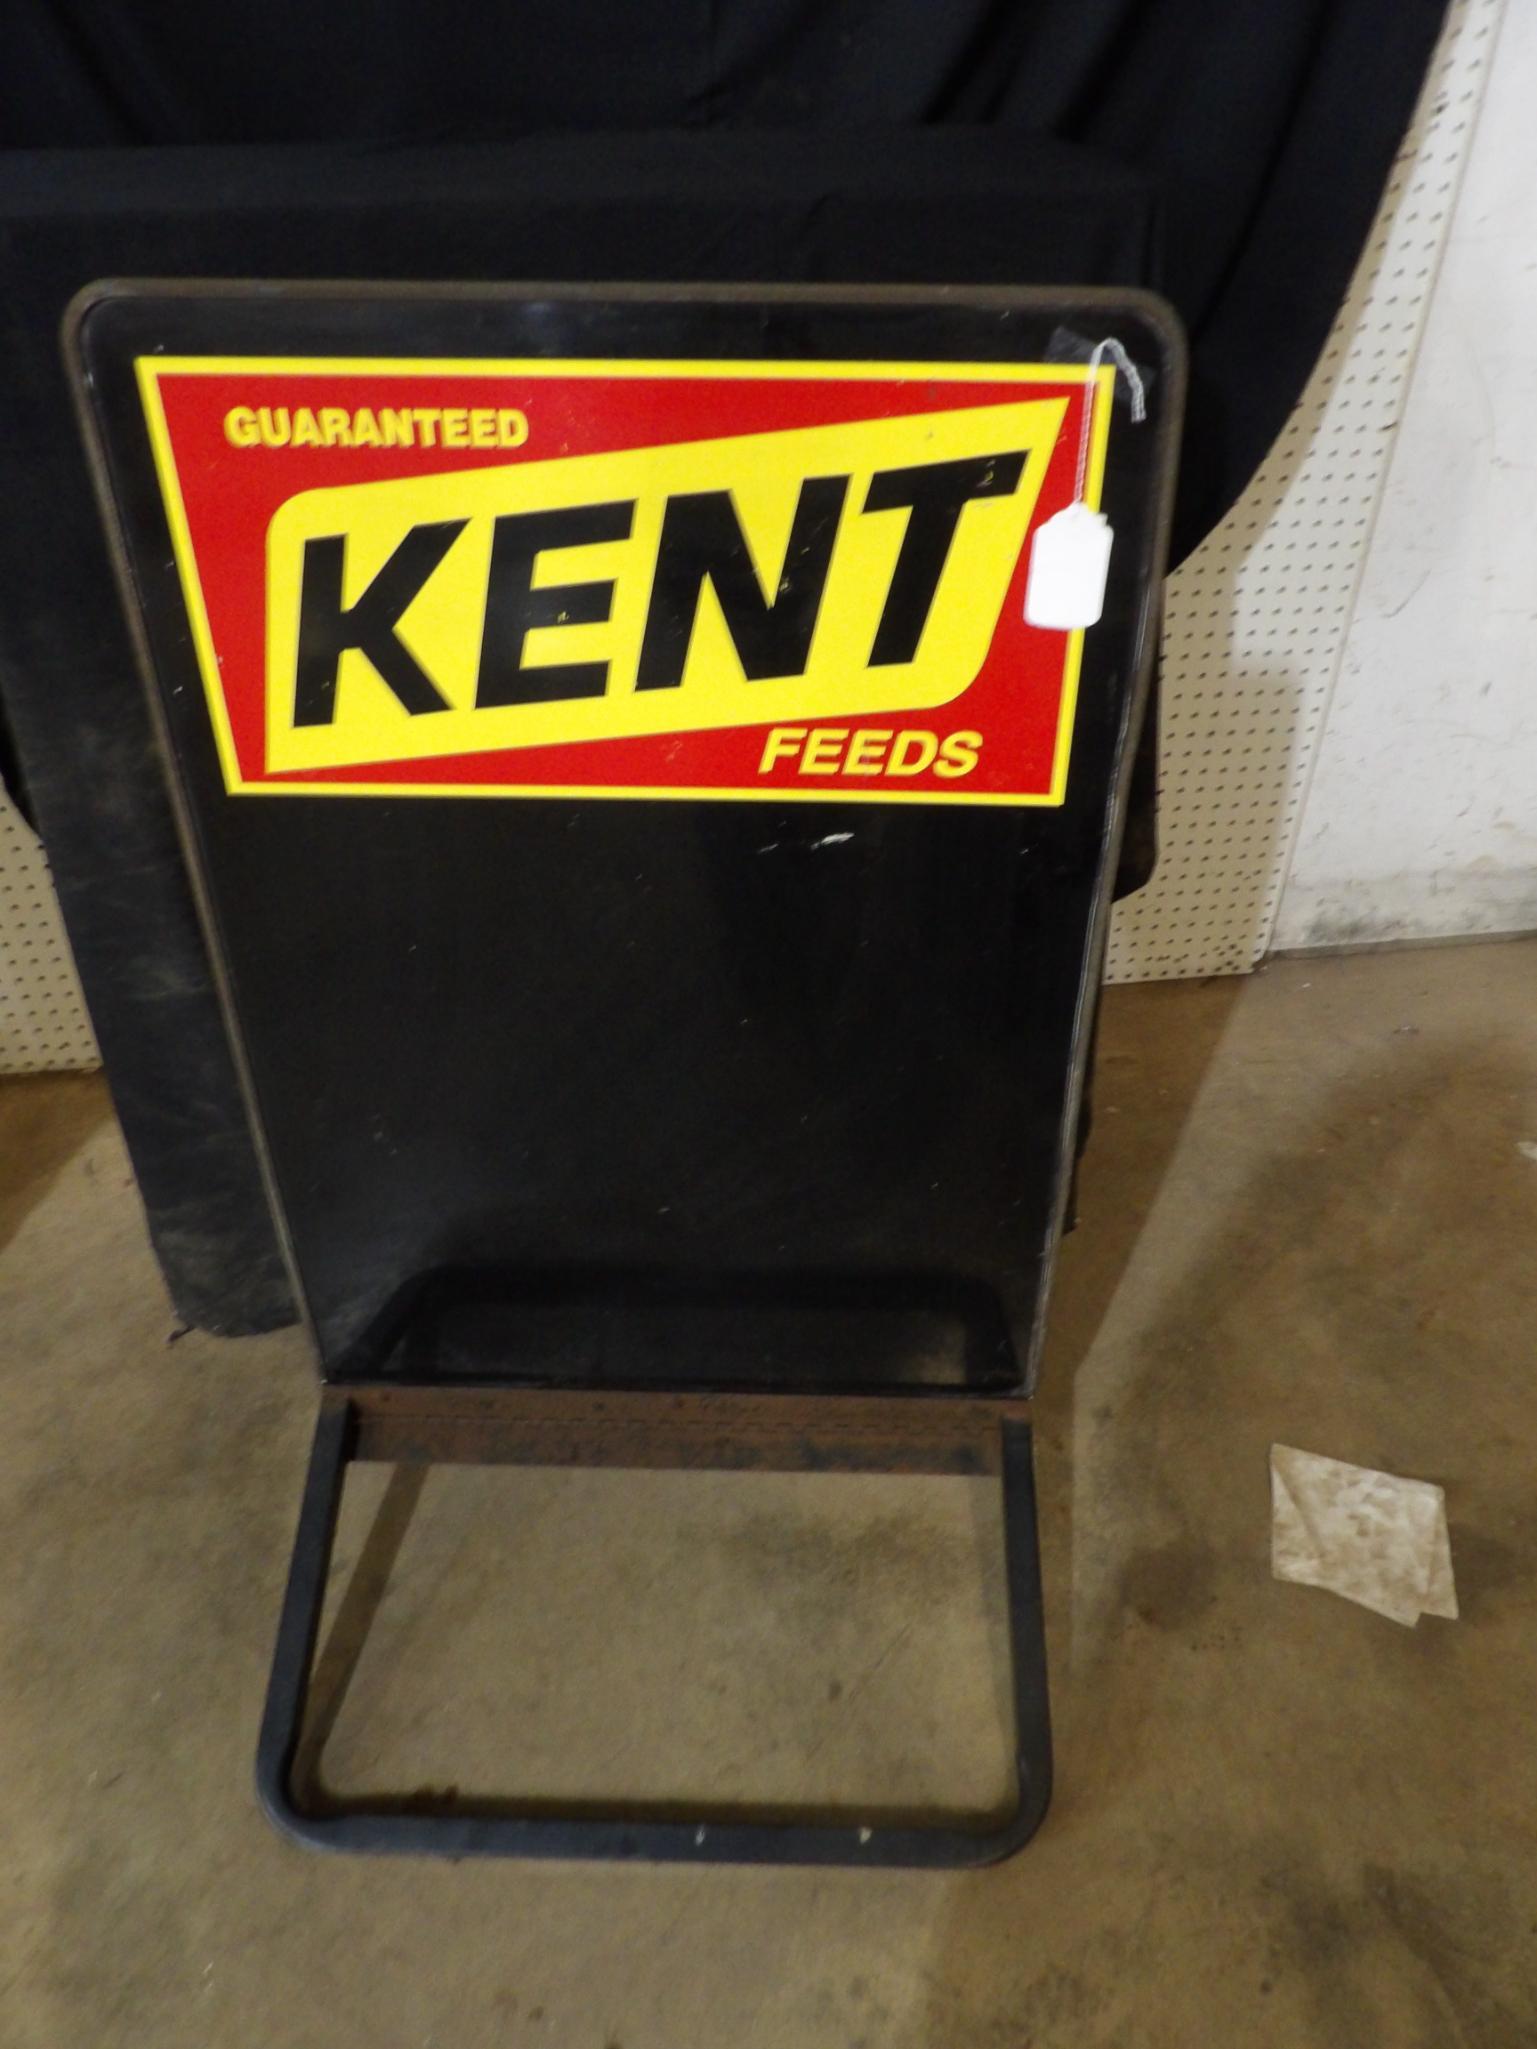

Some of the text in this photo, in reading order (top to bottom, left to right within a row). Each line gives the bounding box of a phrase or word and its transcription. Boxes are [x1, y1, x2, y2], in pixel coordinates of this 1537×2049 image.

[223, 406, 529, 449] GUARANTEED
[292, 448, 1032, 729] KENT
[758, 727, 984, 779] FEEDS
